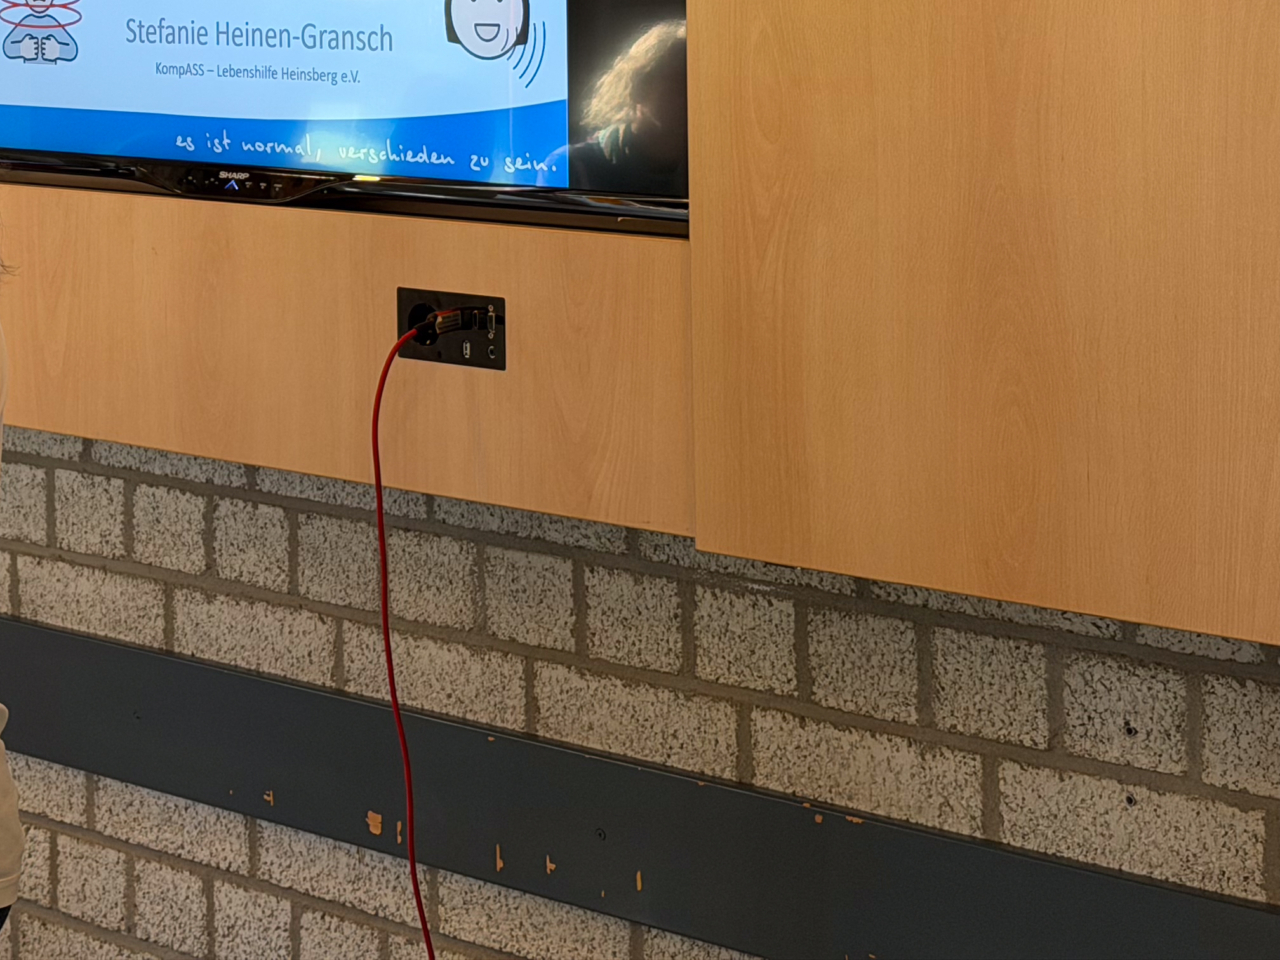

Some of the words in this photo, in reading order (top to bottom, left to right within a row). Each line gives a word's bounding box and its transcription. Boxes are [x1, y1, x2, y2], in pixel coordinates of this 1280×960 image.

[125, 17, 209, 46] Stefanie
[216, 20, 393, 52] Heinen-Gransch
[155, 62, 205, 79] KompASS
[217, 63, 278, 80] Lebenshilfe
[281, 66, 338, 86] Heinsberg
[341, 70, 361, 84] e.V.
[175, 135, 195, 152] es
[206, 129, 231, 153] ist
[242, 133, 321, 162] normal,
[339, 138, 455, 165] verschieden
[470, 154, 489, 171] zu
[504, 152, 557, 173] sein.
[219, 170, 250, 180] SHARP
